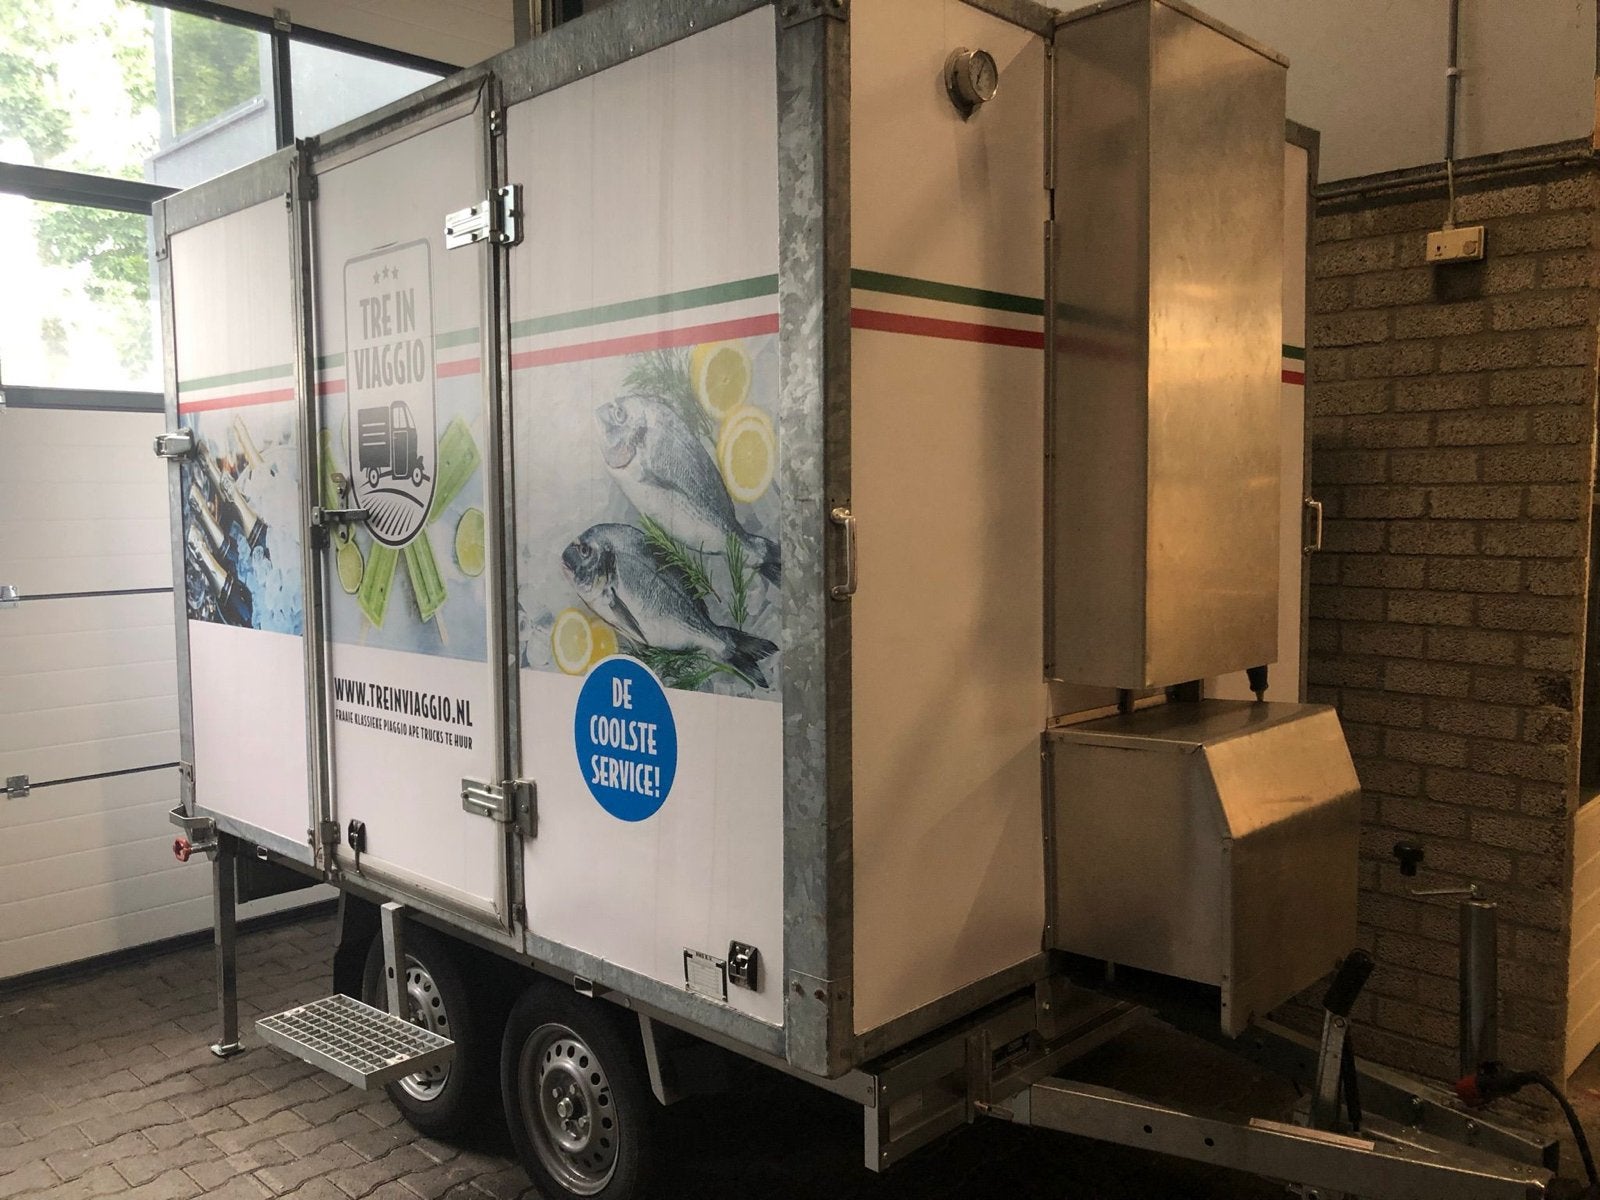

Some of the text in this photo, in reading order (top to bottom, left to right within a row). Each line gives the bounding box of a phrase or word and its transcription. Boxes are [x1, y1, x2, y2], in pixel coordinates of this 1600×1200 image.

[360, 288, 416, 340] TRE IN
[354, 338, 425, 390] VIAGGIO
[335, 677, 473, 727] WWW.TREINVIAGGIO.NL
[612, 677, 633, 709] DE
[355, 713, 382, 730] KLASSIEKE
[384, 719, 408, 736] PIAGGIO
[409, 725, 420, 739] APE
[421, 727, 444, 744] TRUCKS
[445, 732, 453, 746] TE
[454, 736, 473, 750] HUUR
[590, 714, 657, 755] COOLSTE
[591, 754, 660, 798] SERVICE!
